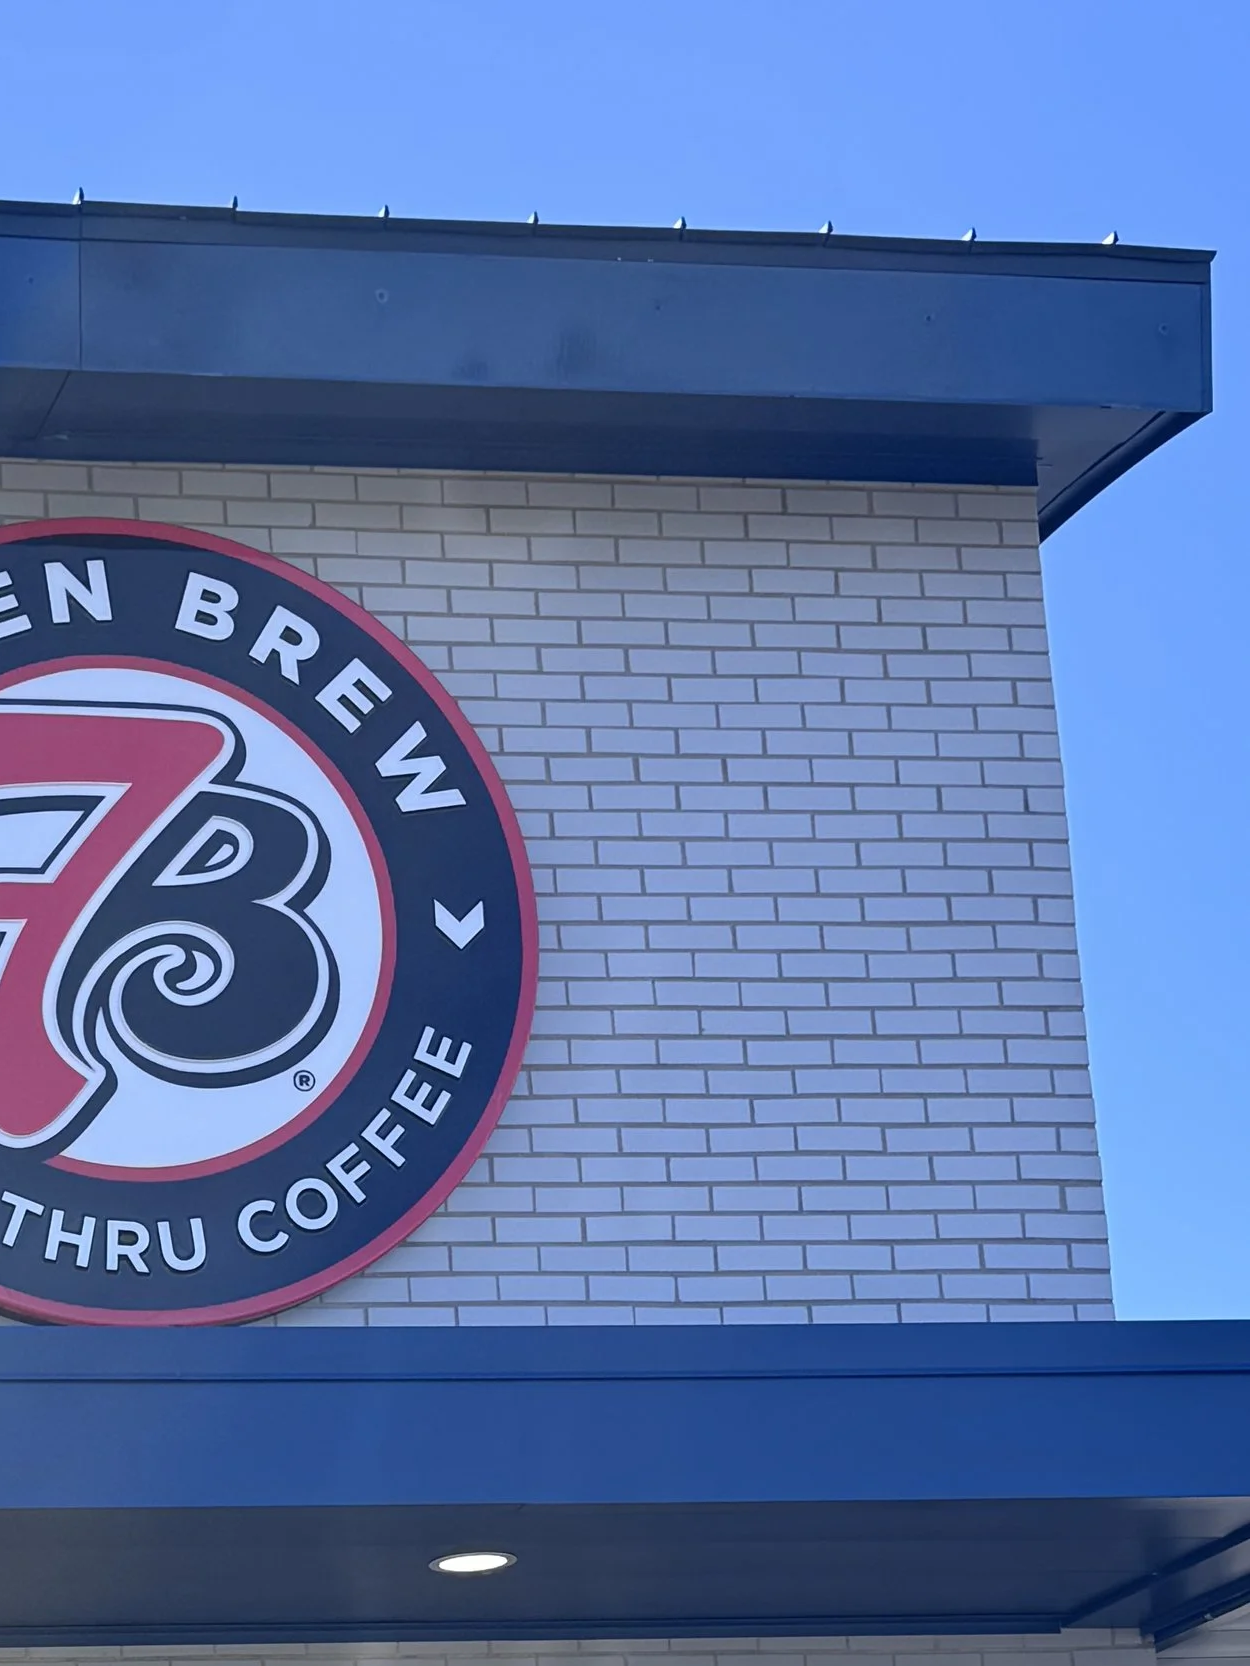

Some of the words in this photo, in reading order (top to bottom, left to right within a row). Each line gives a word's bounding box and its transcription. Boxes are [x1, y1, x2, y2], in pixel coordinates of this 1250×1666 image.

[174, 571, 468, 814] BREW
[0, 1190, 208, 1274] THRU
[237, 1025, 473, 1254] COFFEE
